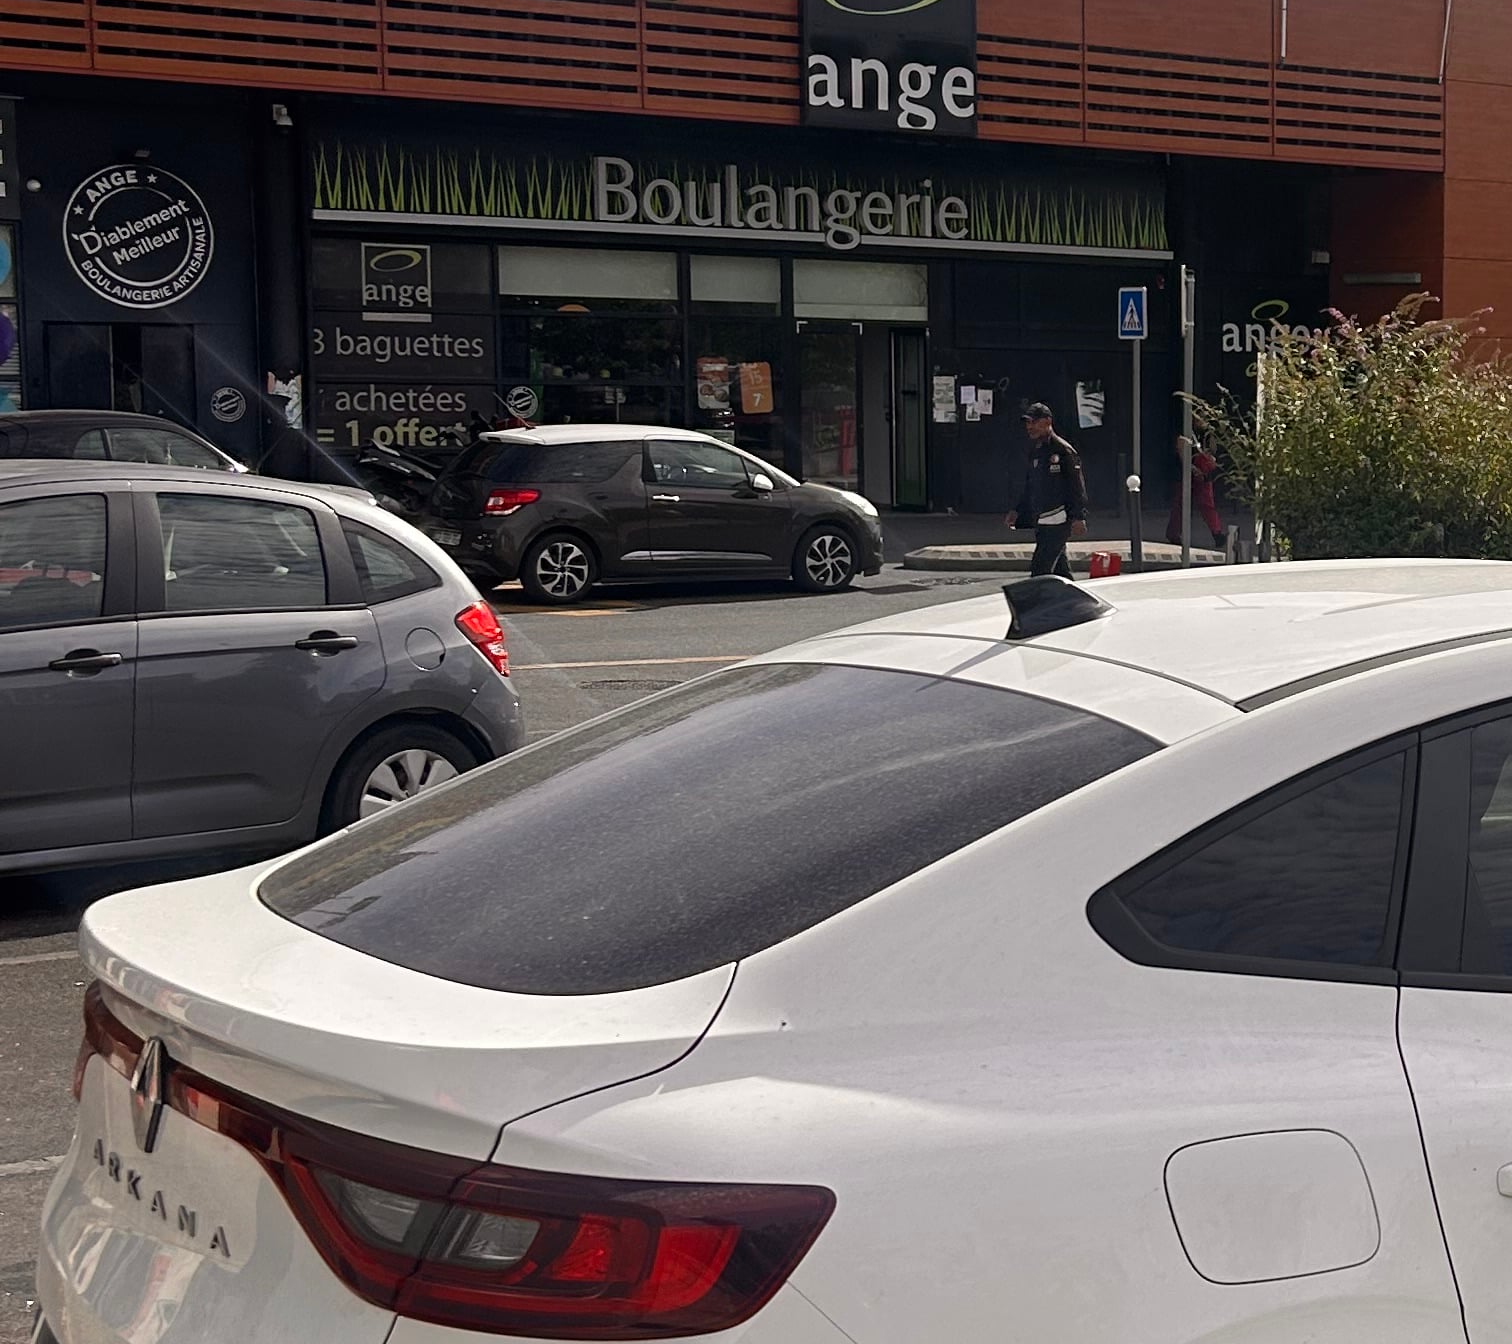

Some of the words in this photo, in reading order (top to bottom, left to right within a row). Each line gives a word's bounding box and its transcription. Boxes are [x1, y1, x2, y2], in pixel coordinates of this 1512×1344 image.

[808, 54, 975, 131] ange
[86, 170, 139, 203] ANGE
[593, 156, 970, 251] Boulangerie
[78, 199, 190, 255] Diablement
[112, 226, 181, 266] Meilleur
[80, 259, 174, 302] BOULANGERIE
[173, 215, 207, 293] ARTISANALE
[363, 282, 431, 308] ange
[313, 327, 326, 355] 3
[335, 326, 485, 364] baguettes
[335, 383, 467, 413] achetées
[345, 419, 360, 447] 1
[93, 1138, 232, 1258] ARKANA
